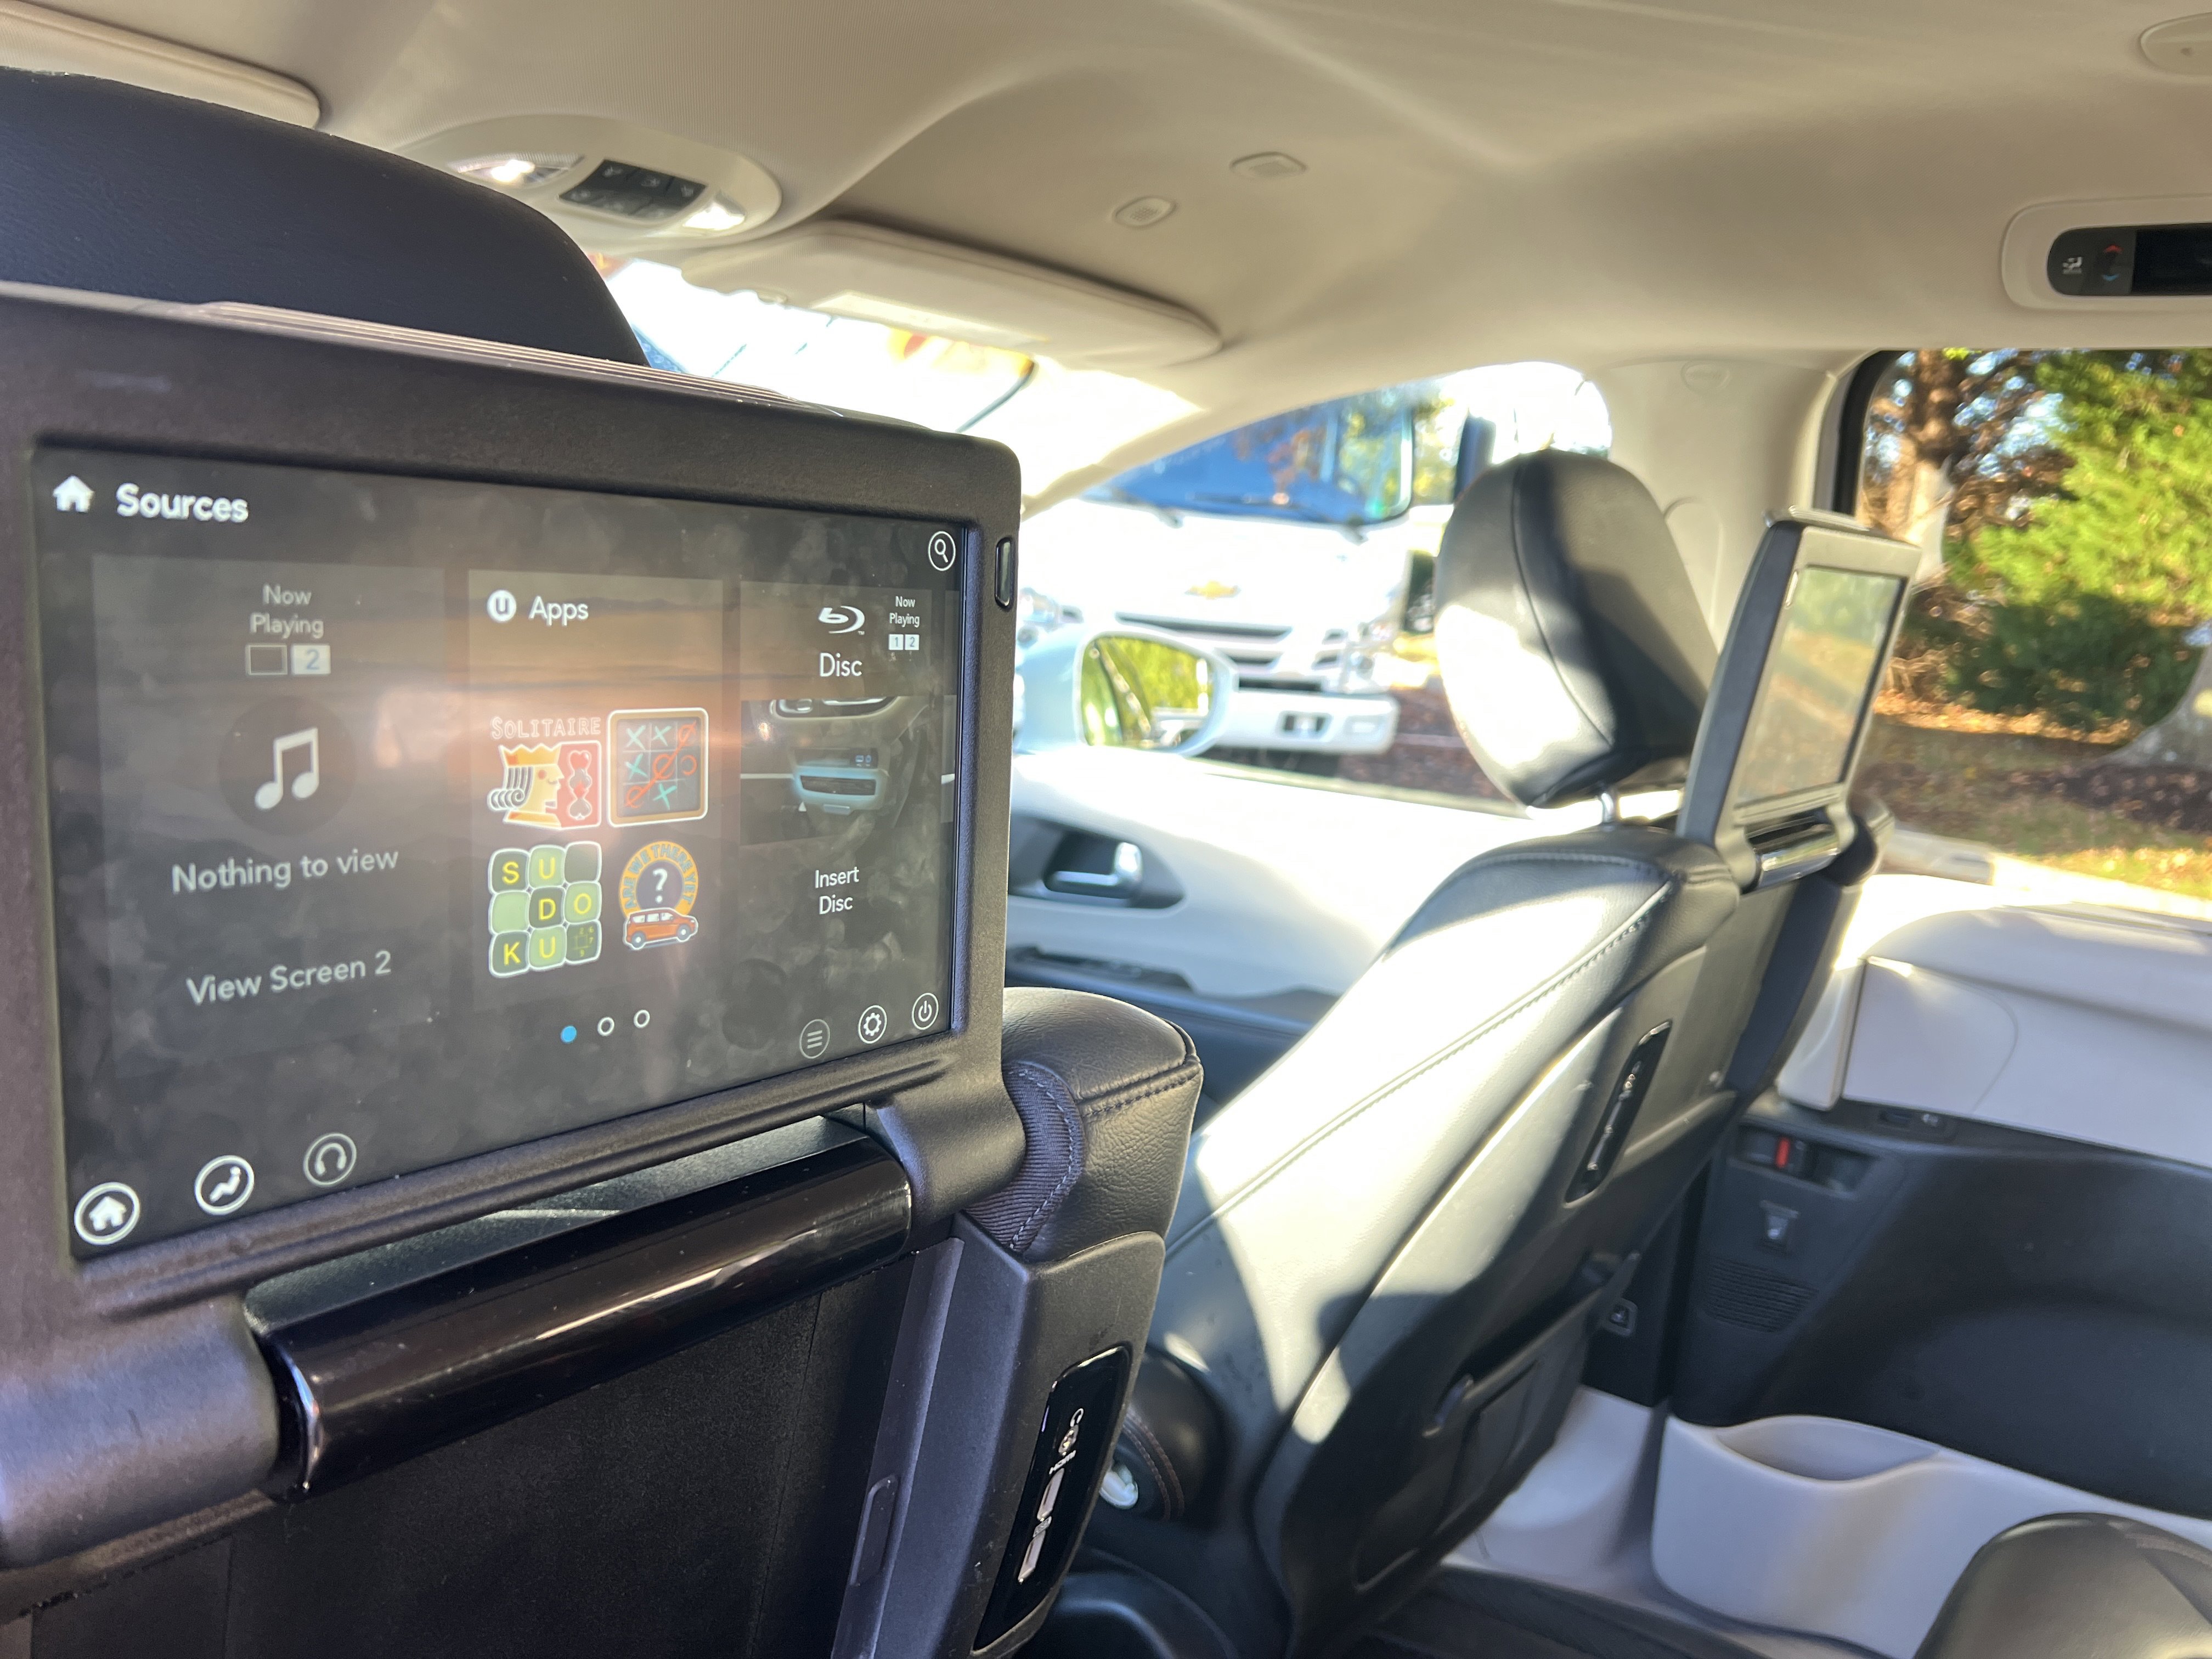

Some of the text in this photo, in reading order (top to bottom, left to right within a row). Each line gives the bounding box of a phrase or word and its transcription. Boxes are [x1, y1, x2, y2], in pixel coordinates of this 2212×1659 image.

[116, 482, 249, 523] Sources
[262, 584, 312, 606] Now
[895, 596, 916, 607] Now
[528, 595, 589, 627] Apps
[889, 612, 920, 628] Playing
[250, 613, 324, 639] Playing
[304, 650, 320, 671] 2
[820, 652, 862, 677] Disc
[492, 716, 601, 740] SOLITAIRE
[172, 848, 399, 895] Nothing to view
[628, 850, 651, 874] WE
[651, 843, 693, 873] THERE
[682, 871, 697, 905] YET
[815, 866, 860, 888] Insert
[819, 895, 853, 915] Disc
[186, 950, 393, 1006] View Screen 2
